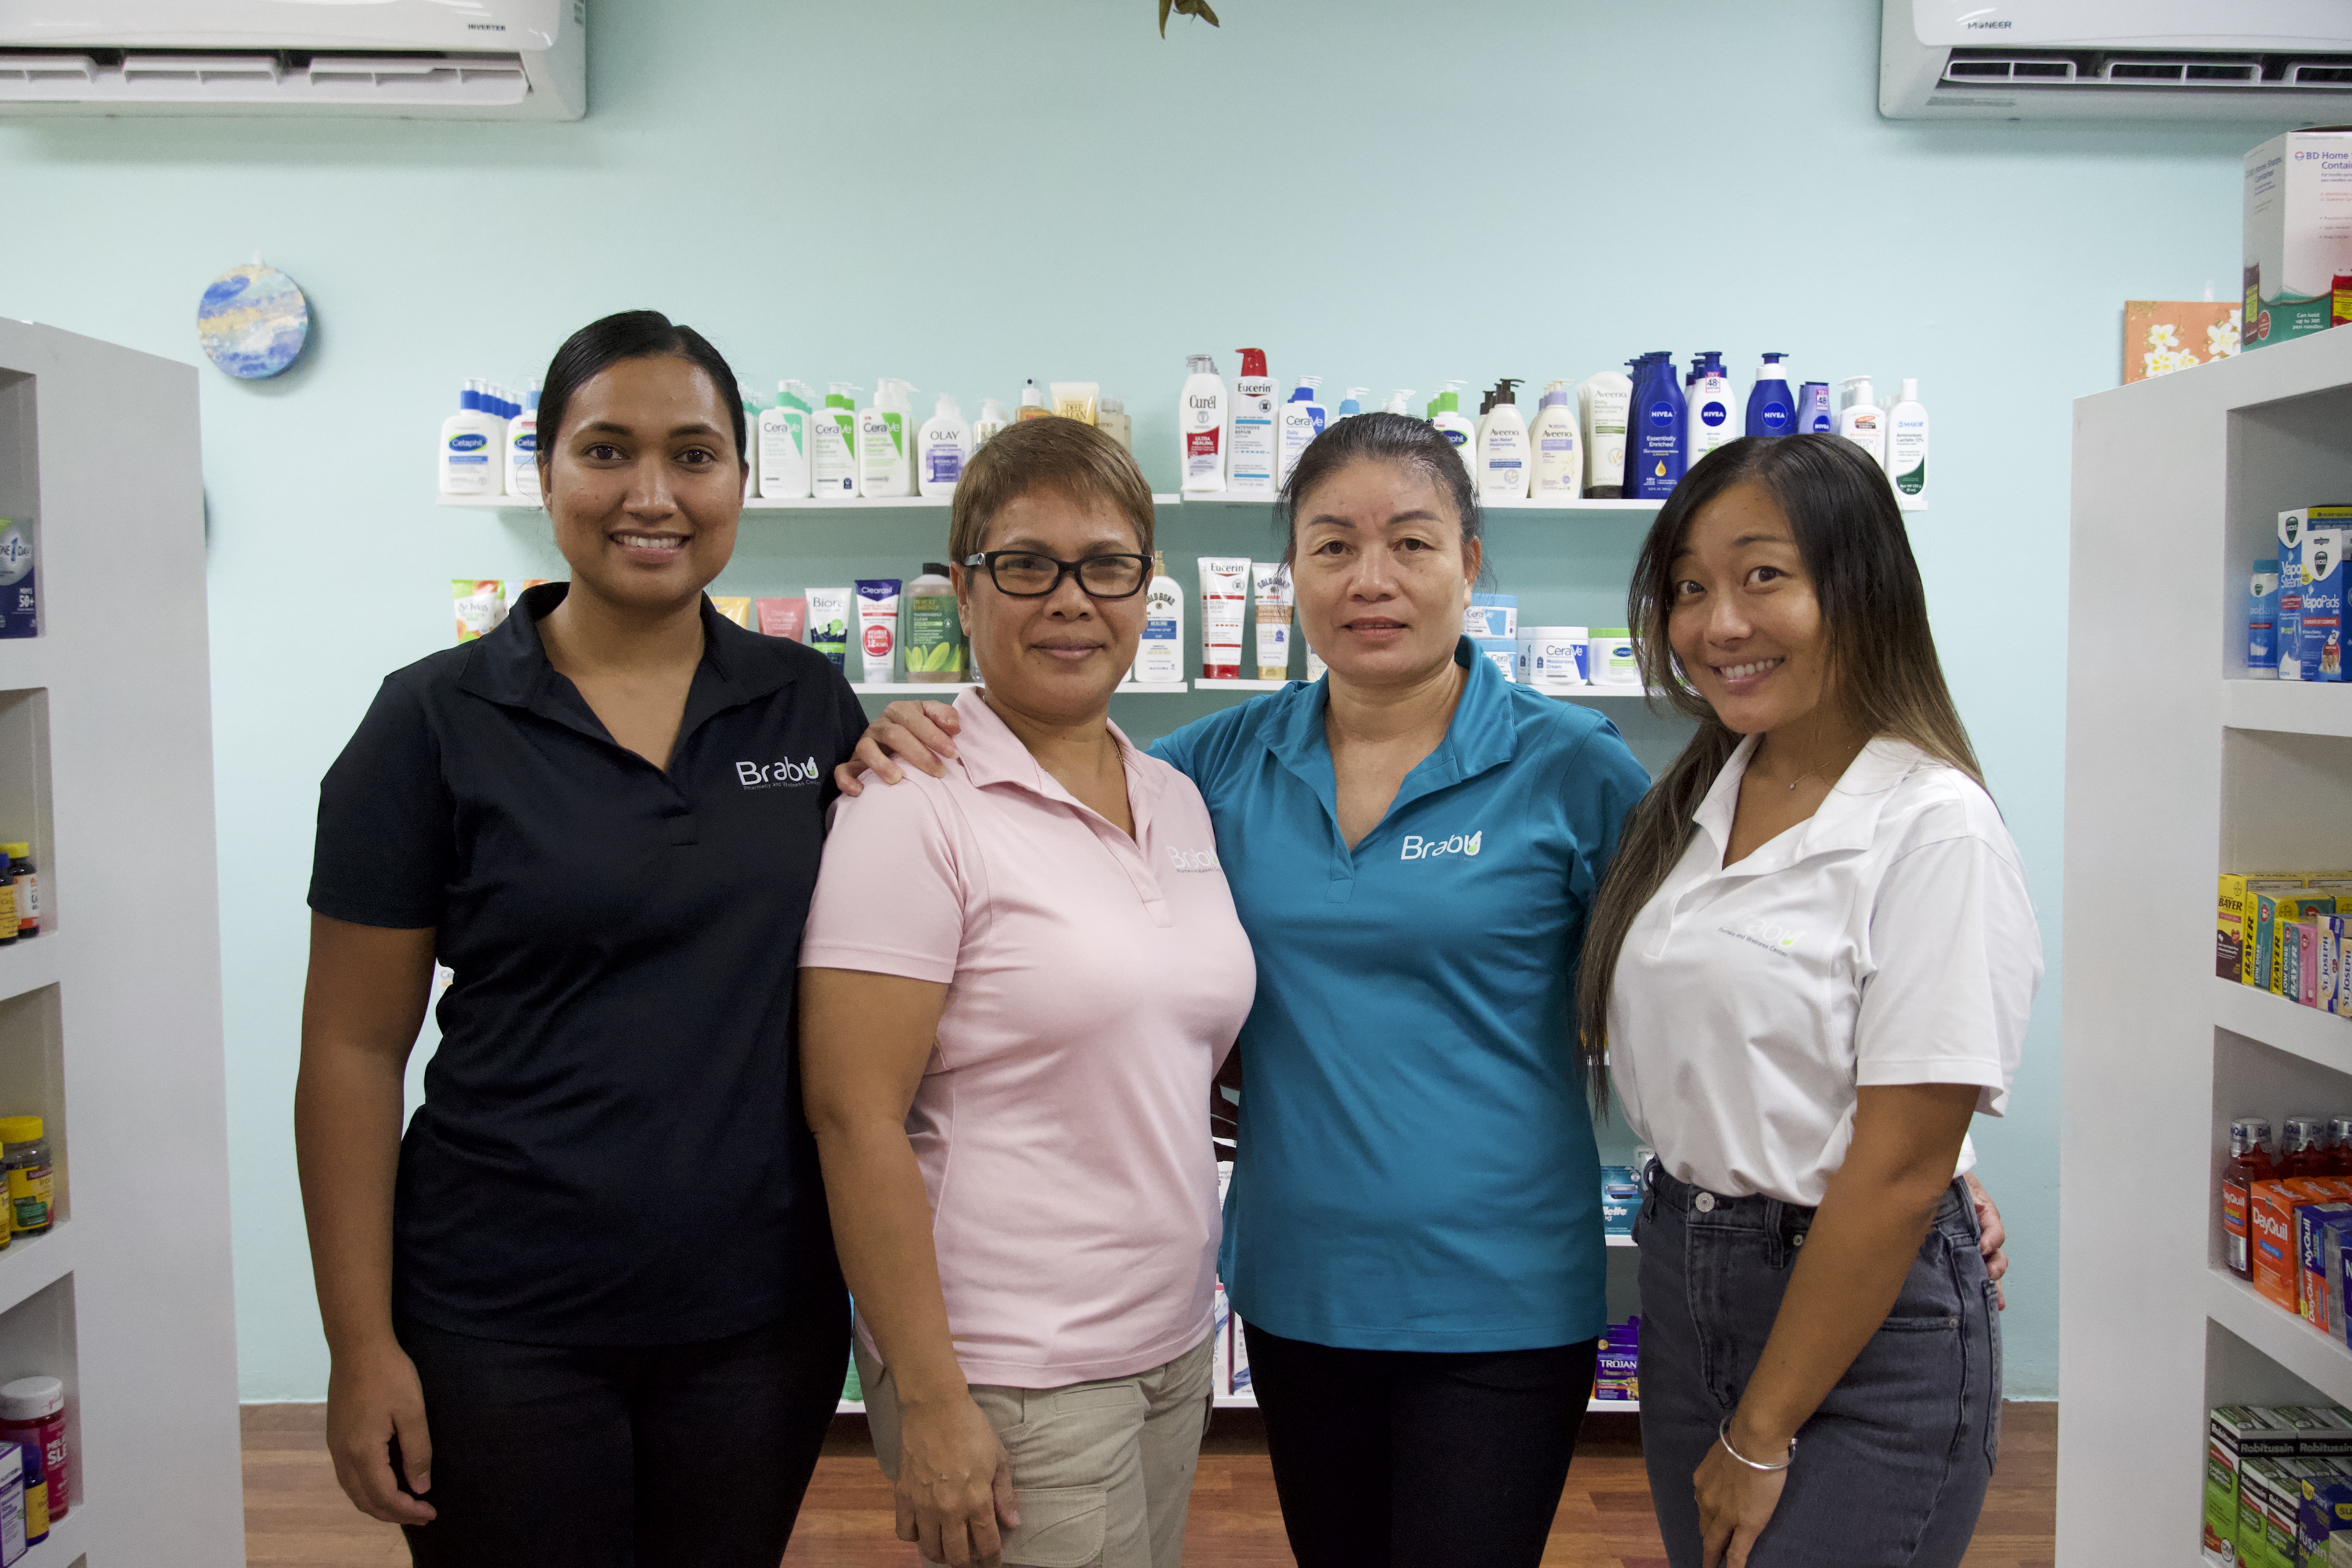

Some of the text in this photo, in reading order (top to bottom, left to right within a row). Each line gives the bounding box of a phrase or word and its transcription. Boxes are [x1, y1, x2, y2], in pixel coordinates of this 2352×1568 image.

[1967, 21, 2012, 29] PIONEER
[2306, 152, 2319, 160] BD
[1237, 383, 1271, 393] Eucerin
[1189, 395, 1216, 409] Curél
[764, 422, 800, 433] CeraVe
[863, 421, 900, 433] CeraVe
[1286, 416, 1323, 427] CeraVe
[815, 423, 852, 434] CeraVe
[930, 431, 960, 440] OLAY
[452, 437, 483, 448] Cetaphil
[1210, 563, 1244, 572] Eucerin
[2281, 561, 2301, 578] Vapo
[1257, 577, 1272, 589] GOLD
[2281, 574, 2302, 588] Steam
[19, 595, 34, 608] 50+
[1147, 592, 1176, 606] OLD BOND
[2302, 593, 2339, 613] VapoPads
[1546, 645, 1583, 656] CeraVe
[735, 756, 819, 786] Brabu
[1401, 830, 1483, 860] Brabu
[2219, 897, 2243, 911] BAYER
[1746, 935, 1769, 949] Wellness
[1769, 945, 1788, 957] Center
[2245, 915, 2254, 977] BAYER
[2343, 950, 2352, 991] JOSEPH
[2223, 1189, 2245, 1207] ayQuil
[2252, 1206, 2288, 1242] DayQuil
[2302, 1217, 2312, 1267] NyQuil
[2305, 1269, 2316, 1323] DayQuil
[1599, 1359, 1637, 1368] TROJAN
[2241, 1443, 2294, 1453] Robitussin
